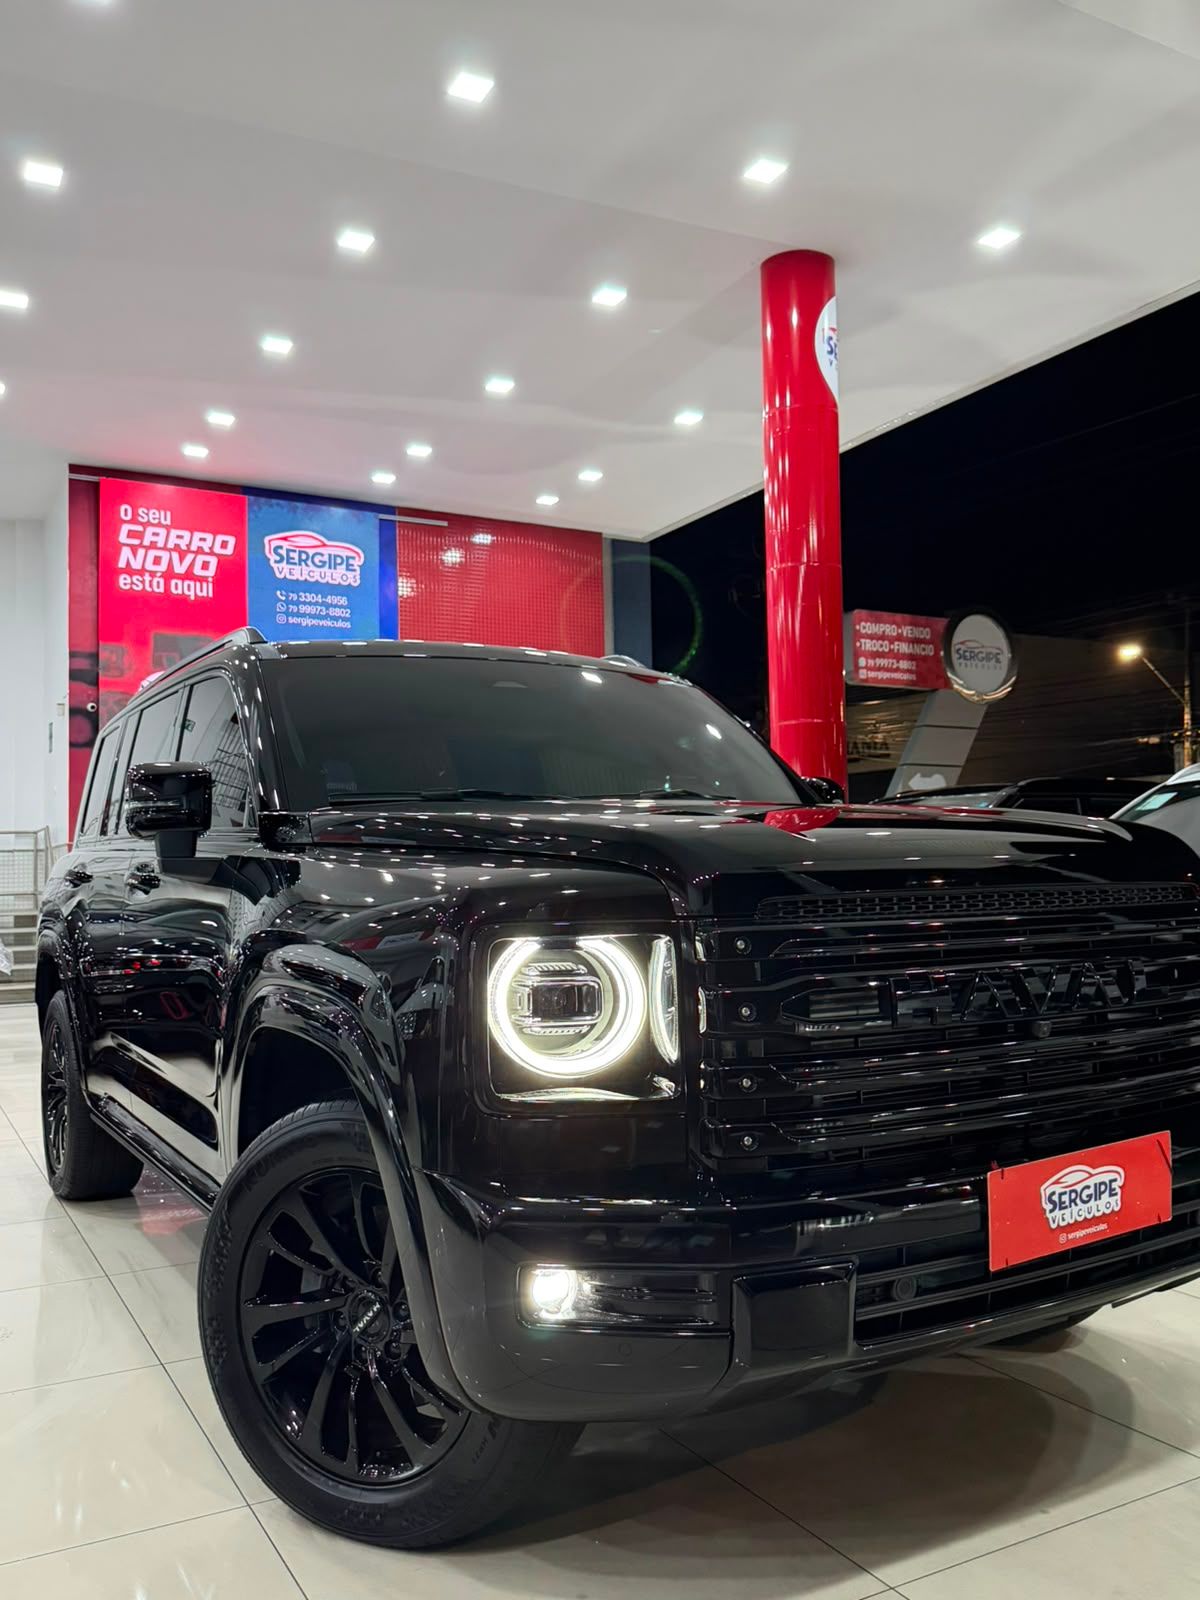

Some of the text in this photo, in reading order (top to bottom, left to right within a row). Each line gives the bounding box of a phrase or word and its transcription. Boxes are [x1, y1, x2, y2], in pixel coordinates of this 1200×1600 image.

[138, 507, 171, 526] seu
[118, 523, 236, 556] CARRO
[117, 547, 219, 577] NOVO
[273, 544, 357, 572] SERGIPE
[118, 570, 214, 600] está aqui
[275, 566, 360, 586] VEÍCULOS
[288, 592, 349, 606] 79 3304-4956
[288, 604, 351, 618] 79 99973-8802
[288, 615, 352, 629] sergipeveiculos
[860, 622, 931, 639] COMPRO VENDO
[860, 639, 890, 652] TROCO
[956, 647, 1002, 664] SERGIPE
[1046, 1178, 1119, 1214] SERGIPE
[1050, 1200, 1120, 1224] VEÍCULOS
